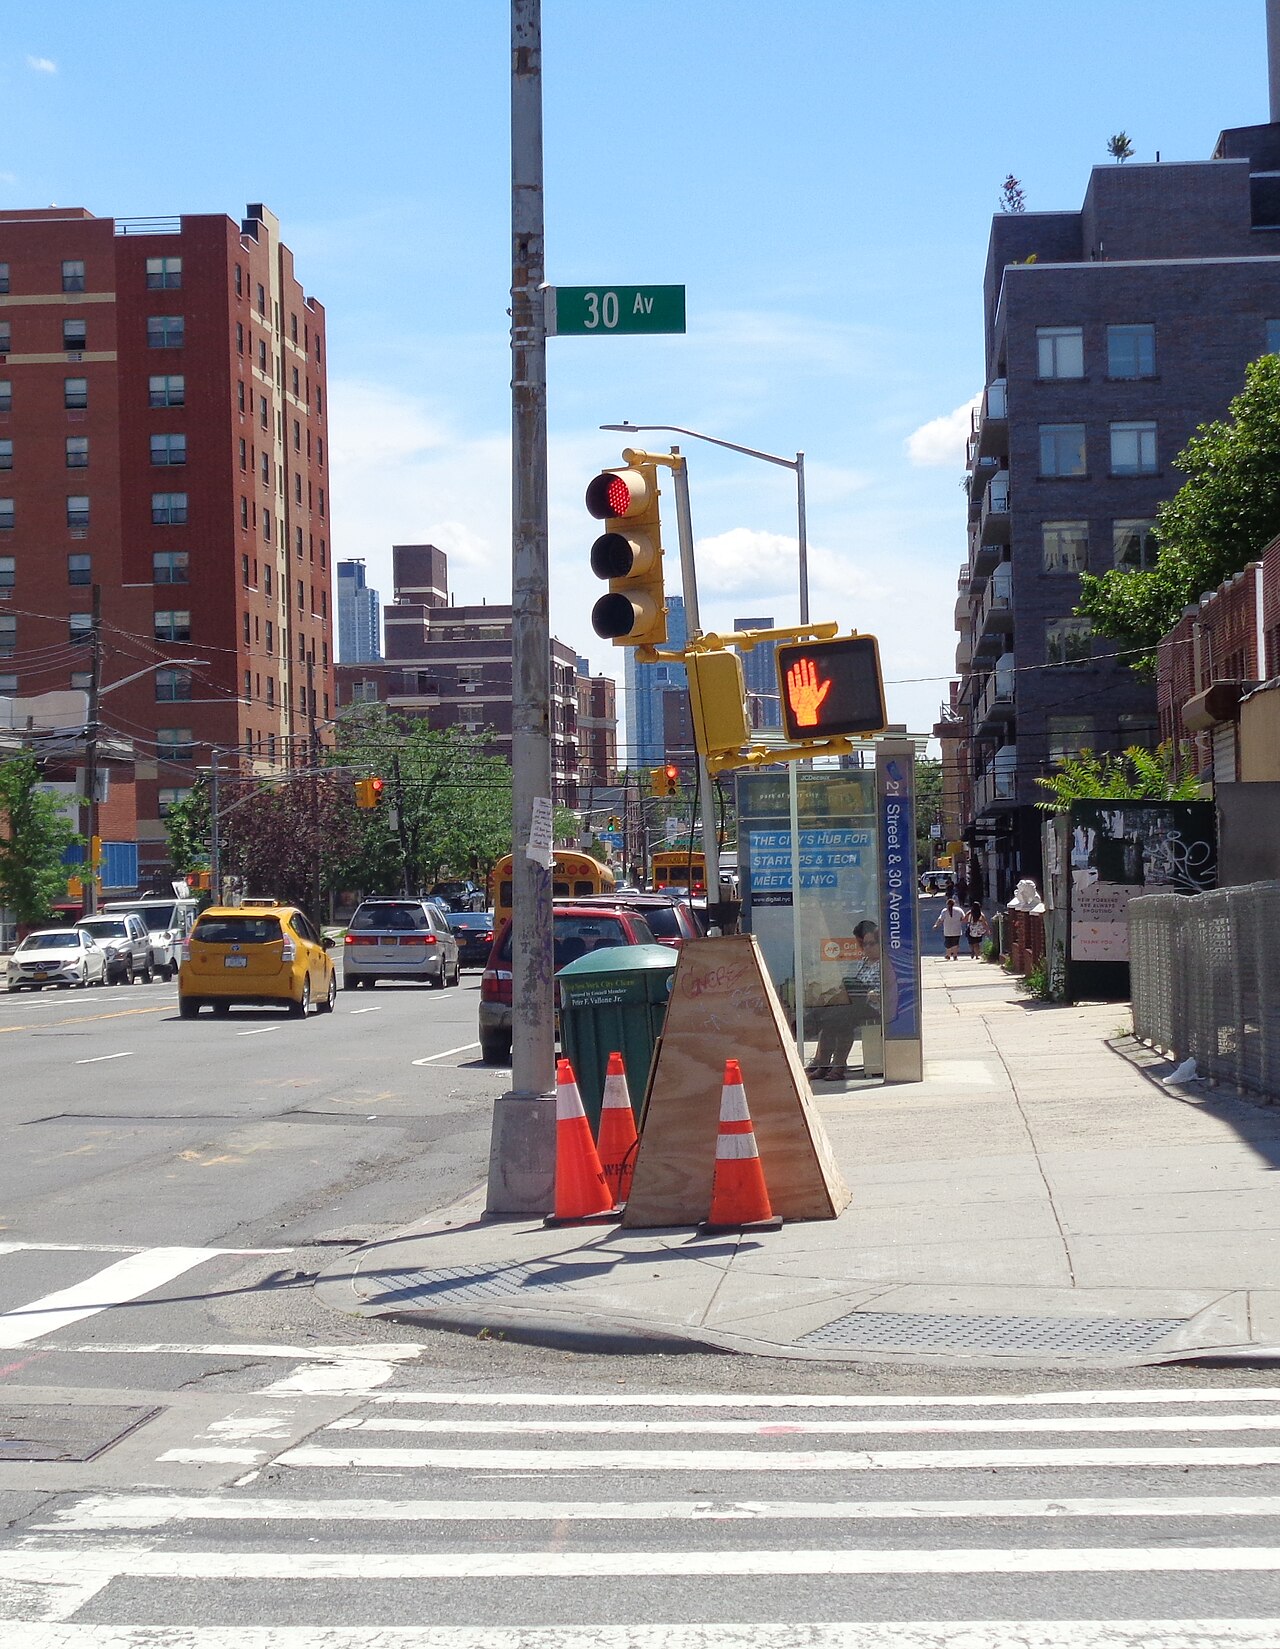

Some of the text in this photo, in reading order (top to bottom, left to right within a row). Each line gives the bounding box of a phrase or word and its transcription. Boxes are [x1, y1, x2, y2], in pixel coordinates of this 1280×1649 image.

[583, 291, 654, 329] 30 Av
[753, 833, 868, 846] THE CIY'S HUB FOR
[815, 855, 824, 865] &
[827, 854, 857, 864] TECH
[886, 781, 902, 950] 21 Street & 30 Avenue
[753, 875, 786, 886] MEET
[807, 874, 835, 884] .NYC
